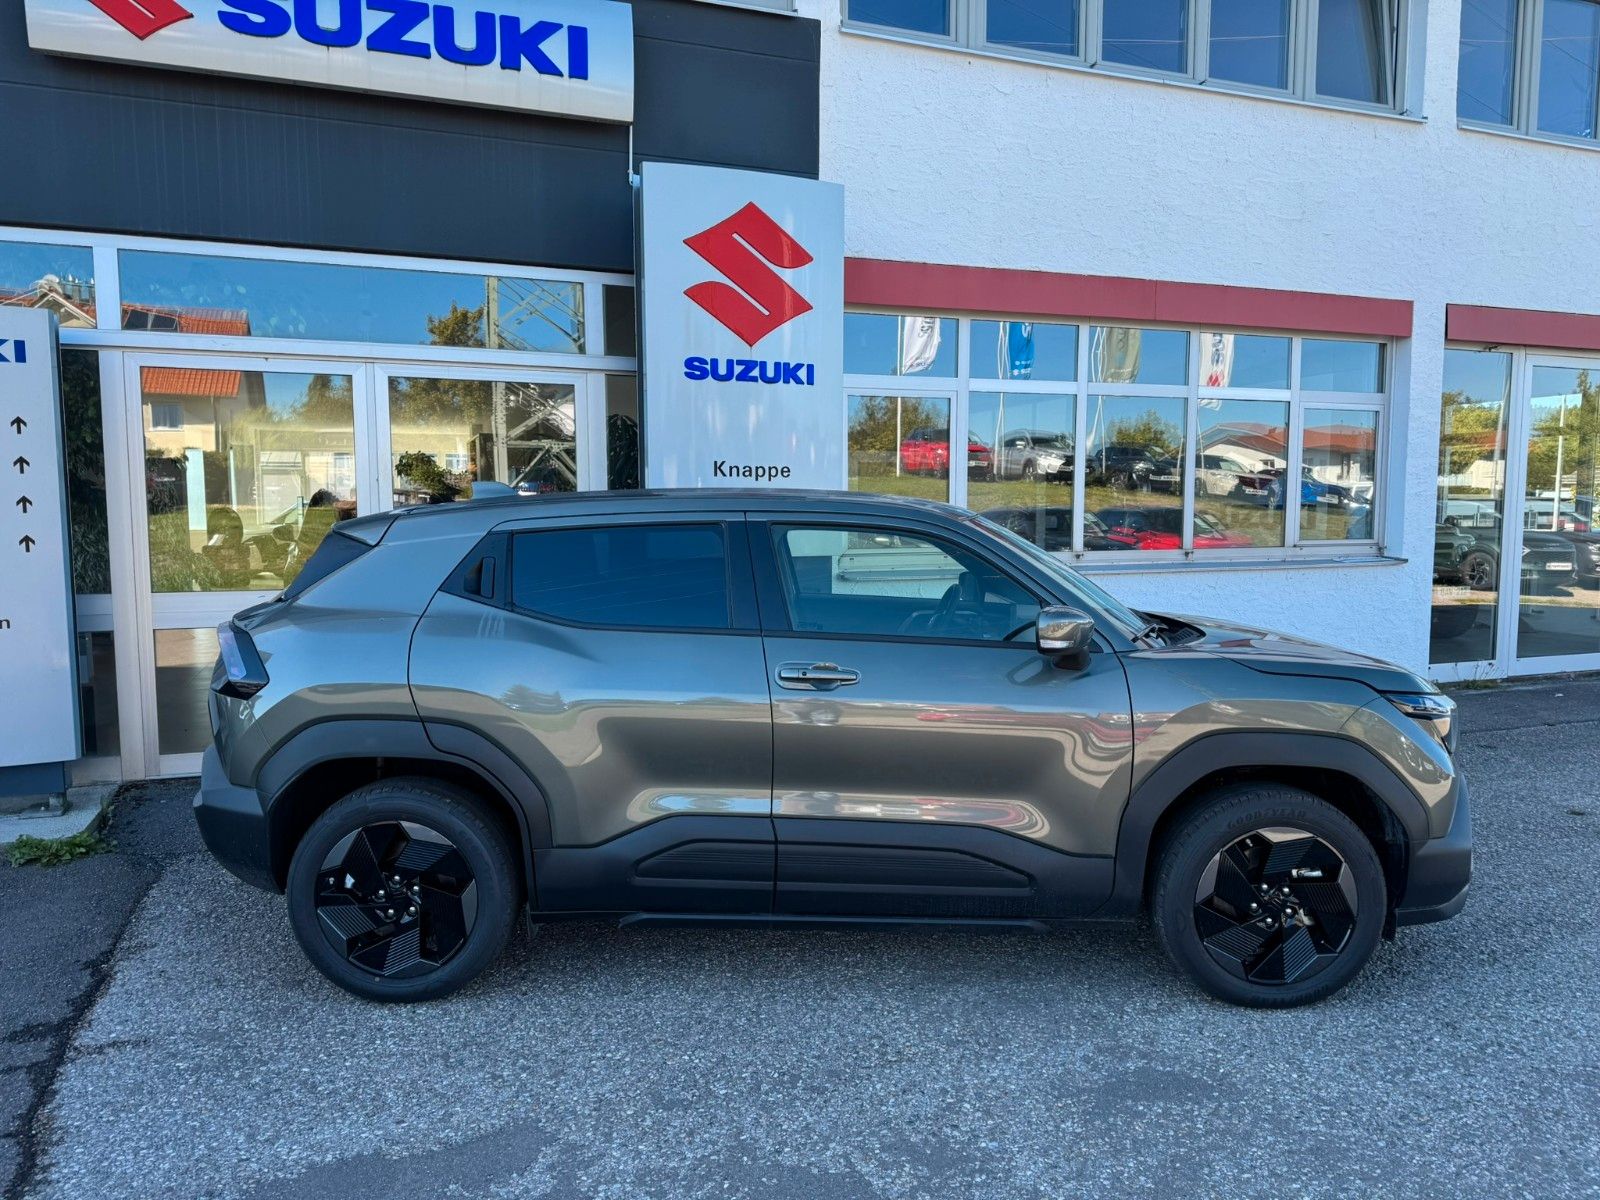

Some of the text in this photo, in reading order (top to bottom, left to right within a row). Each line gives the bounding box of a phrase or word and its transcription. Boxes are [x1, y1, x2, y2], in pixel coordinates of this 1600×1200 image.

[217, 0, 589, 80] SUZUKI
[684, 356, 815, 385] SUZUKI
[714, 460, 792, 482] Knappe
